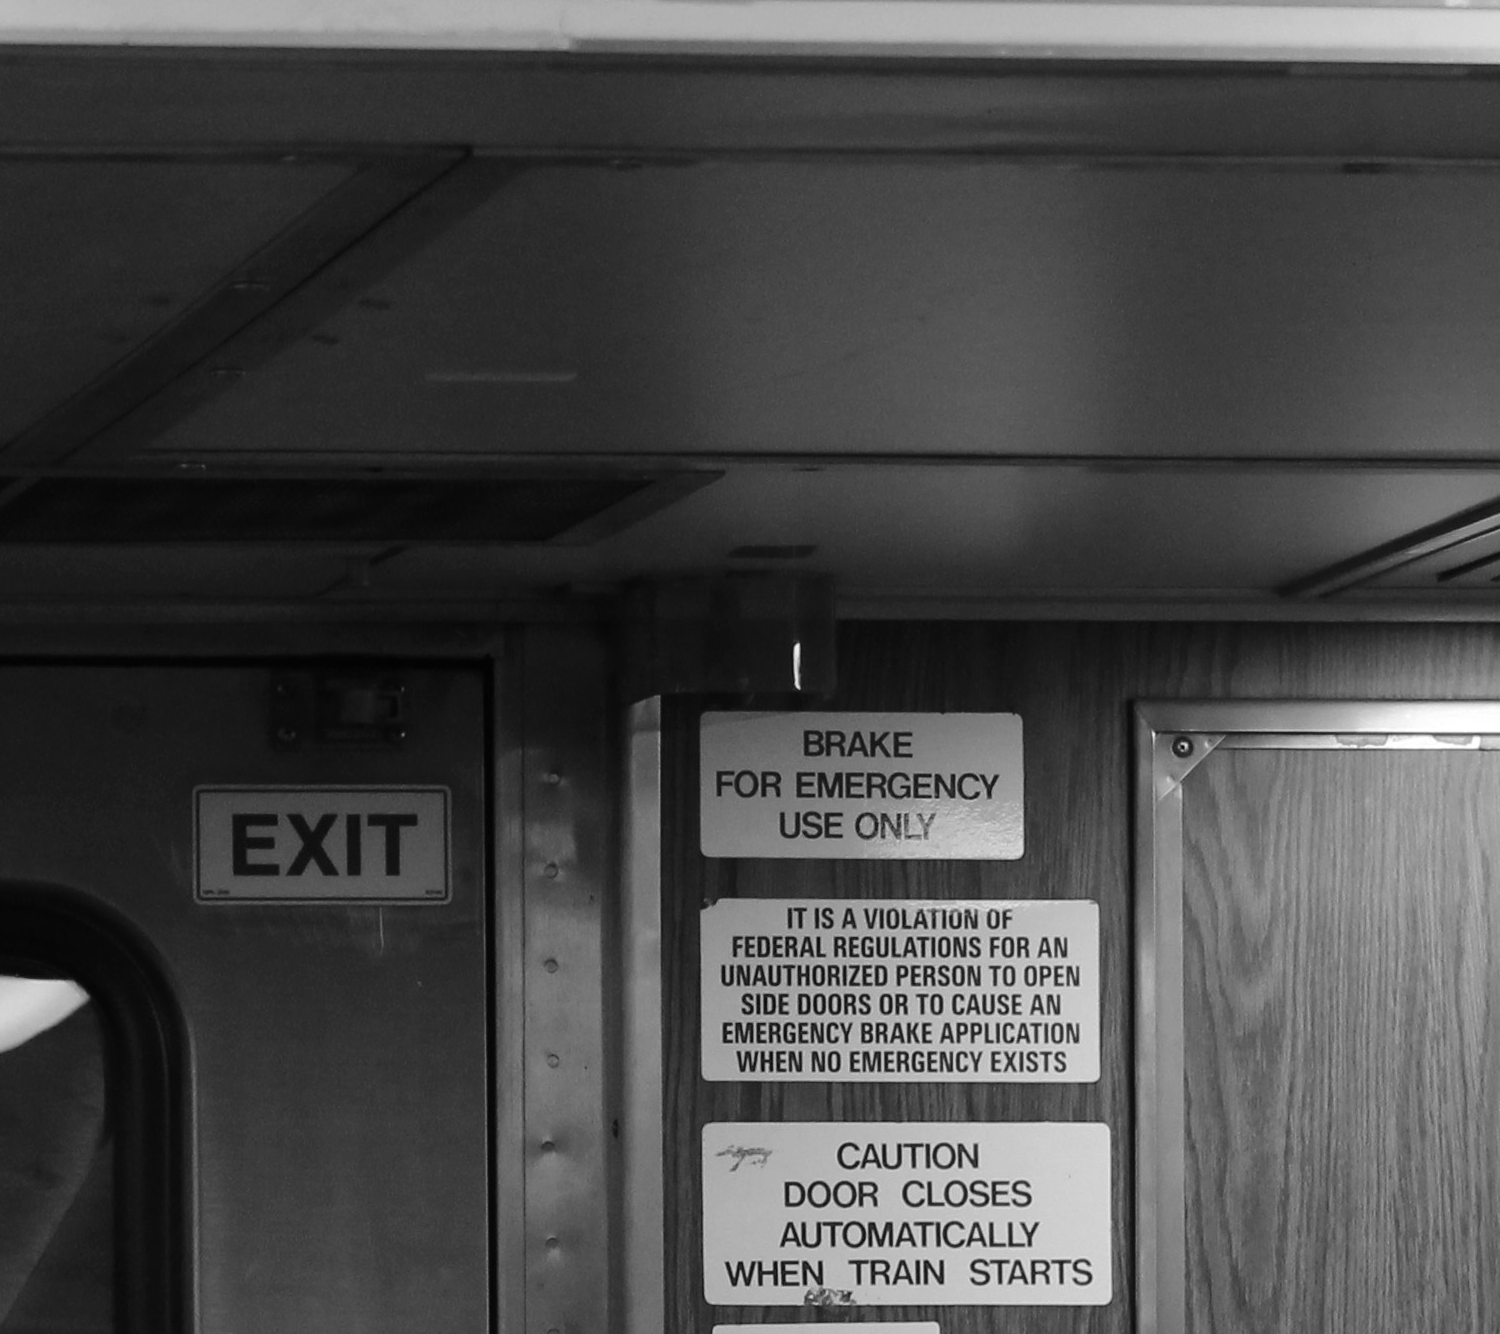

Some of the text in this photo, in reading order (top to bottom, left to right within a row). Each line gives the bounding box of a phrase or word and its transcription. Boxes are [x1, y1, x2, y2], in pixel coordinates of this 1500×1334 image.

[803, 728, 913, 758] BRAKE
[715, 769, 999, 800] FOR EMERGENCY
[779, 810, 936, 841] USE ONLY
[230, 812, 419, 877] EXIT
[787, 907, 1012, 930] IT IS A VIOLATION OF
[732, 934, 1068, 959] FEDERAL REGULATIONS FOR AN
[720, 963, 1080, 987] UNAUTHORIZED PERSON TO OPEN
[741, 992, 1061, 1016] SIDE DOORS OR TO CAUSE AN
[722, 1021, 1080, 1045] EMERGENCY BRAKE APPLICATION
[736, 1049, 1067, 1073] WHEN NO EMERGENCY EXISTS
[836, 1141, 979, 1171] CAUTION
[784, 1179, 1033, 1209] DOOR CLOSES
[779, 1219, 1039, 1250] AUTOMATICALLY
[724, 1257, 1093, 1287] WHEN TRAIN STARTS
